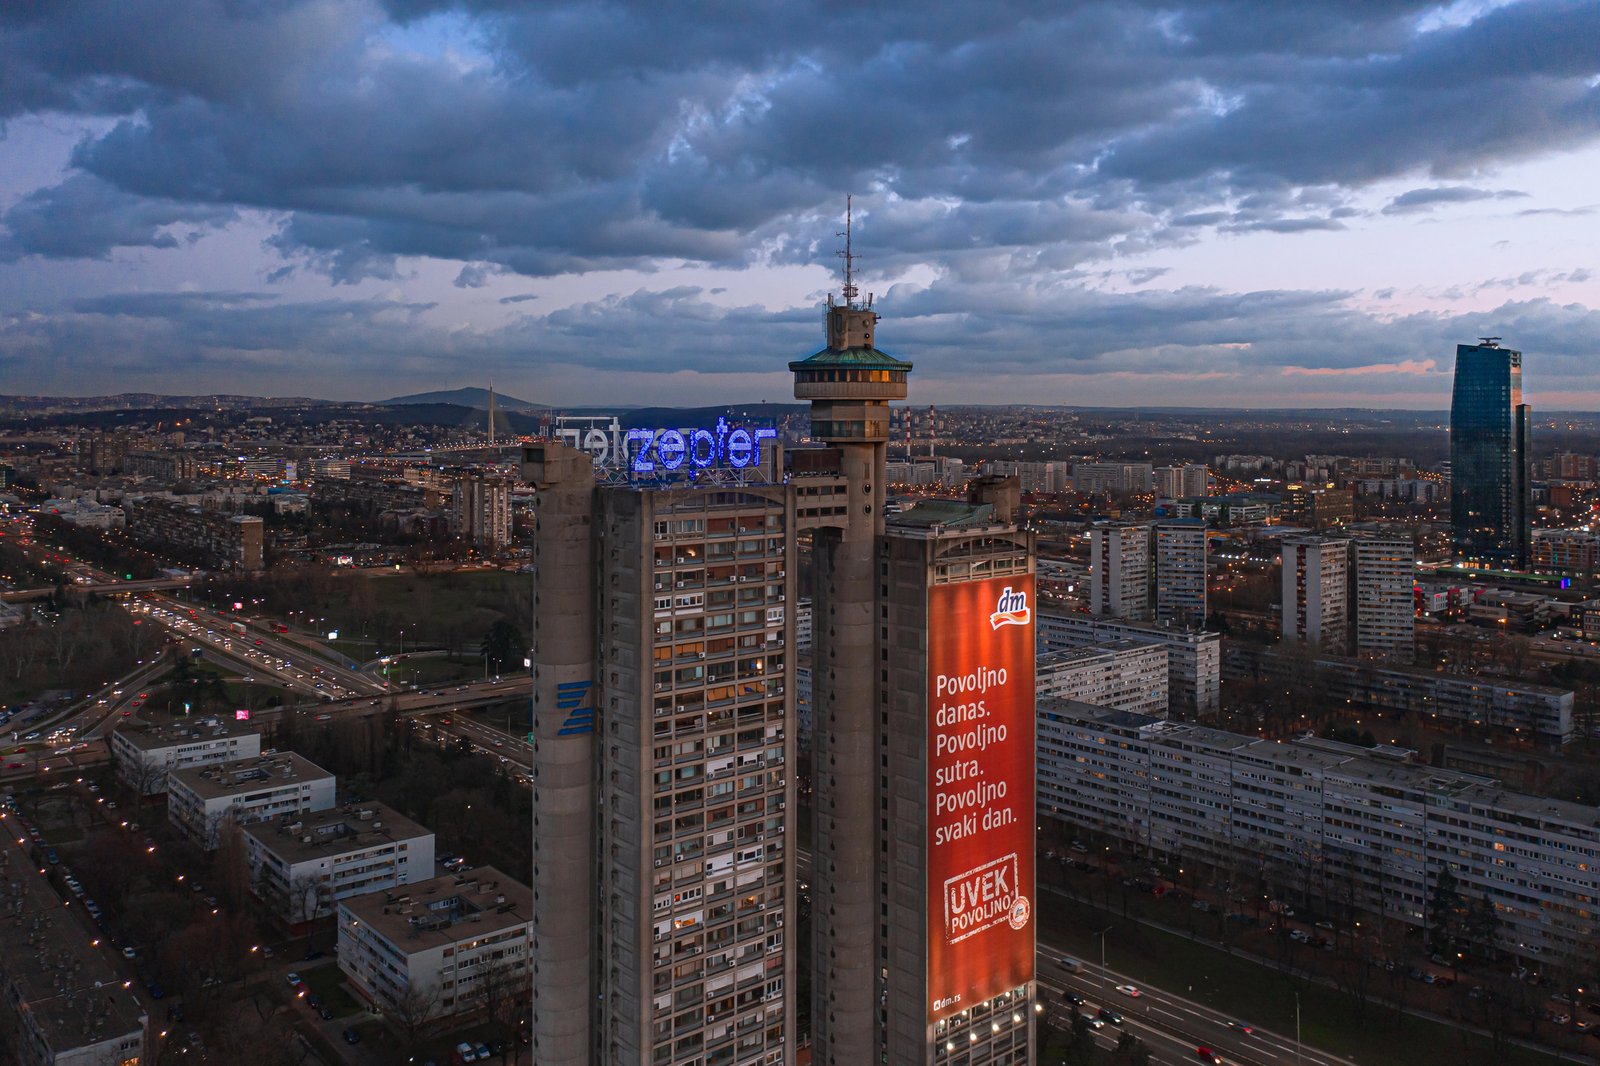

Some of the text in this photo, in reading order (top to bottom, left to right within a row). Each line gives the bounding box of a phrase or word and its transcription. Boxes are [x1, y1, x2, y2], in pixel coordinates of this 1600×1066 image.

[627, 416, 776, 481] zepter
[999, 589, 1025, 613] dm
[937, 667, 1008, 698] Povoljno
[937, 700, 991, 727] danas.
[936, 723, 1008, 757] Povoljno
[936, 759, 985, 787] sutra.
[936, 780, 1008, 816] Povoljno
[935, 807, 1018, 846] svaki dan.
[951, 865, 1009, 914] UVEK
[951, 894, 1011, 934] POVOLJNO
[940, 994, 961, 1009] dm.rs
